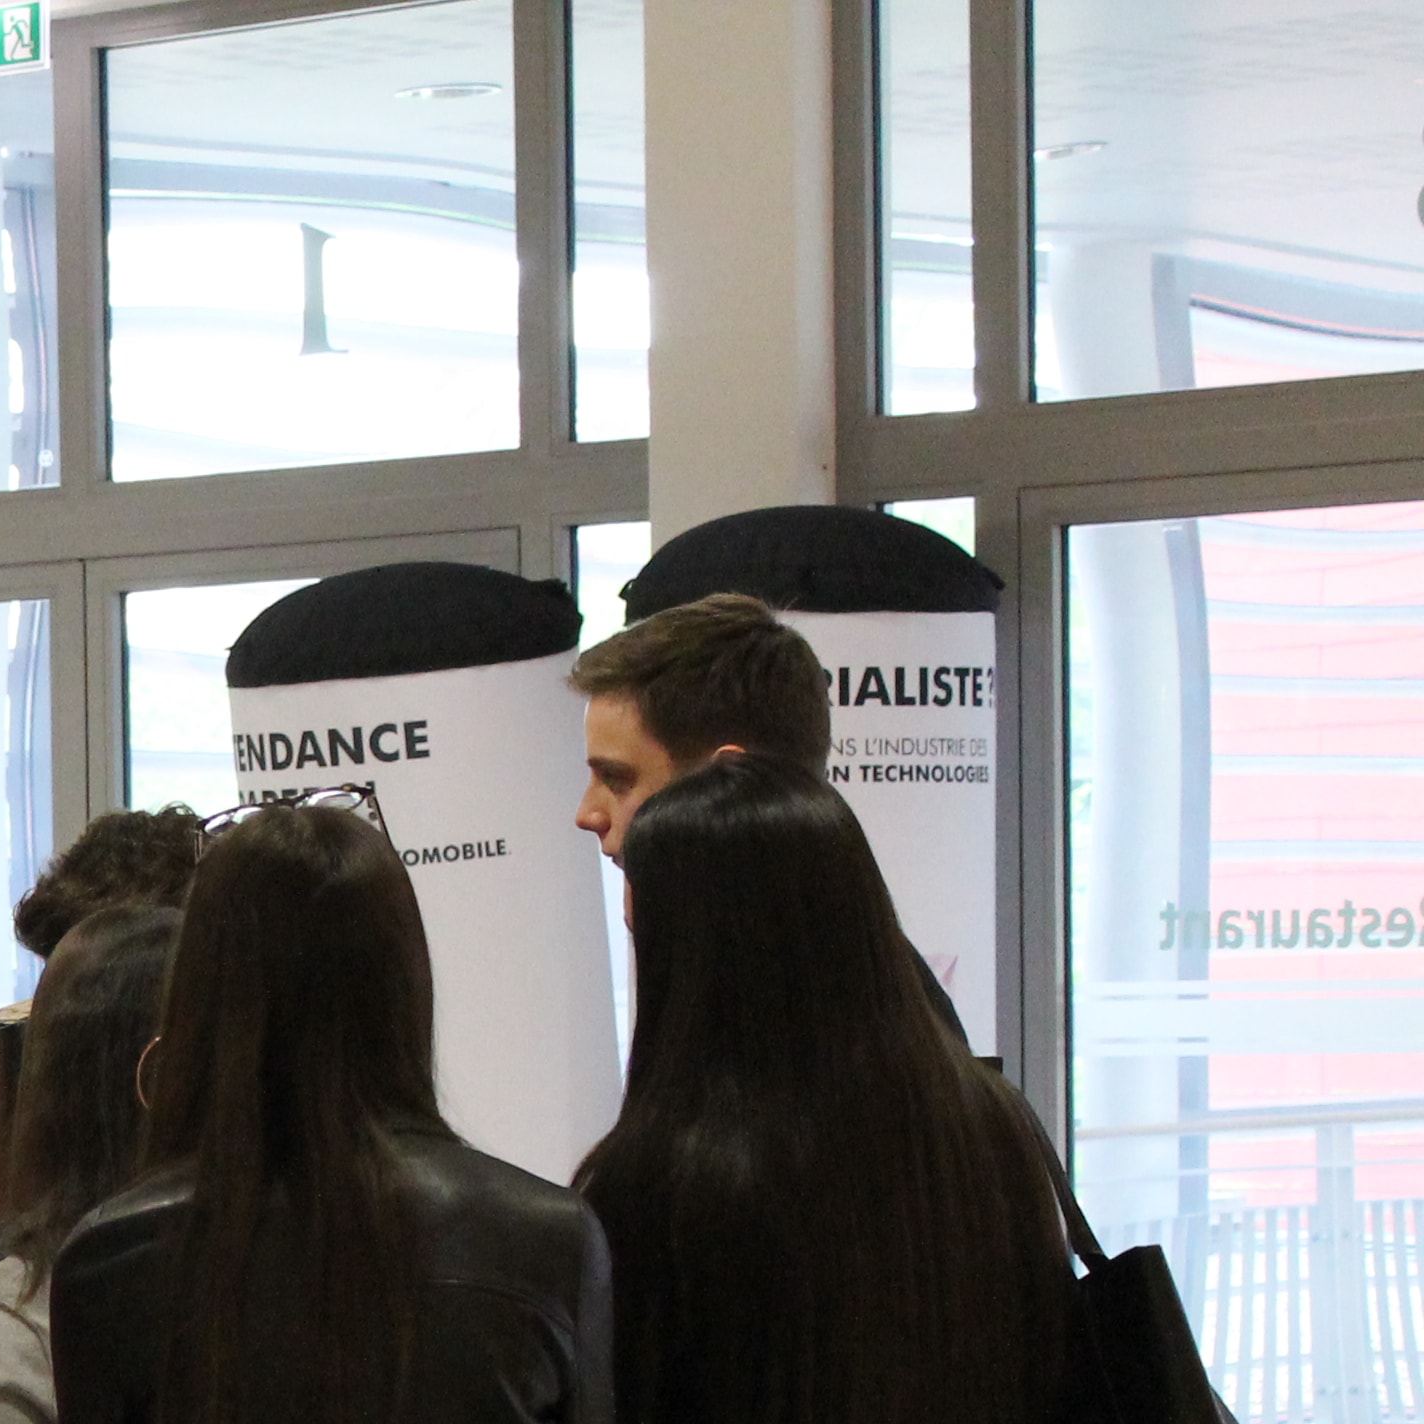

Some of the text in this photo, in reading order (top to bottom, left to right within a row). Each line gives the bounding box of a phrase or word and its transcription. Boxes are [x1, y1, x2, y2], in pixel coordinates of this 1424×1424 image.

[832, 738, 857, 756] NS
[865, 738, 966, 756] L'INDUSTRIE
[859, 764, 989, 783] TECHNOLOGIES
[396, 839, 511, 867] OMOBILE.
